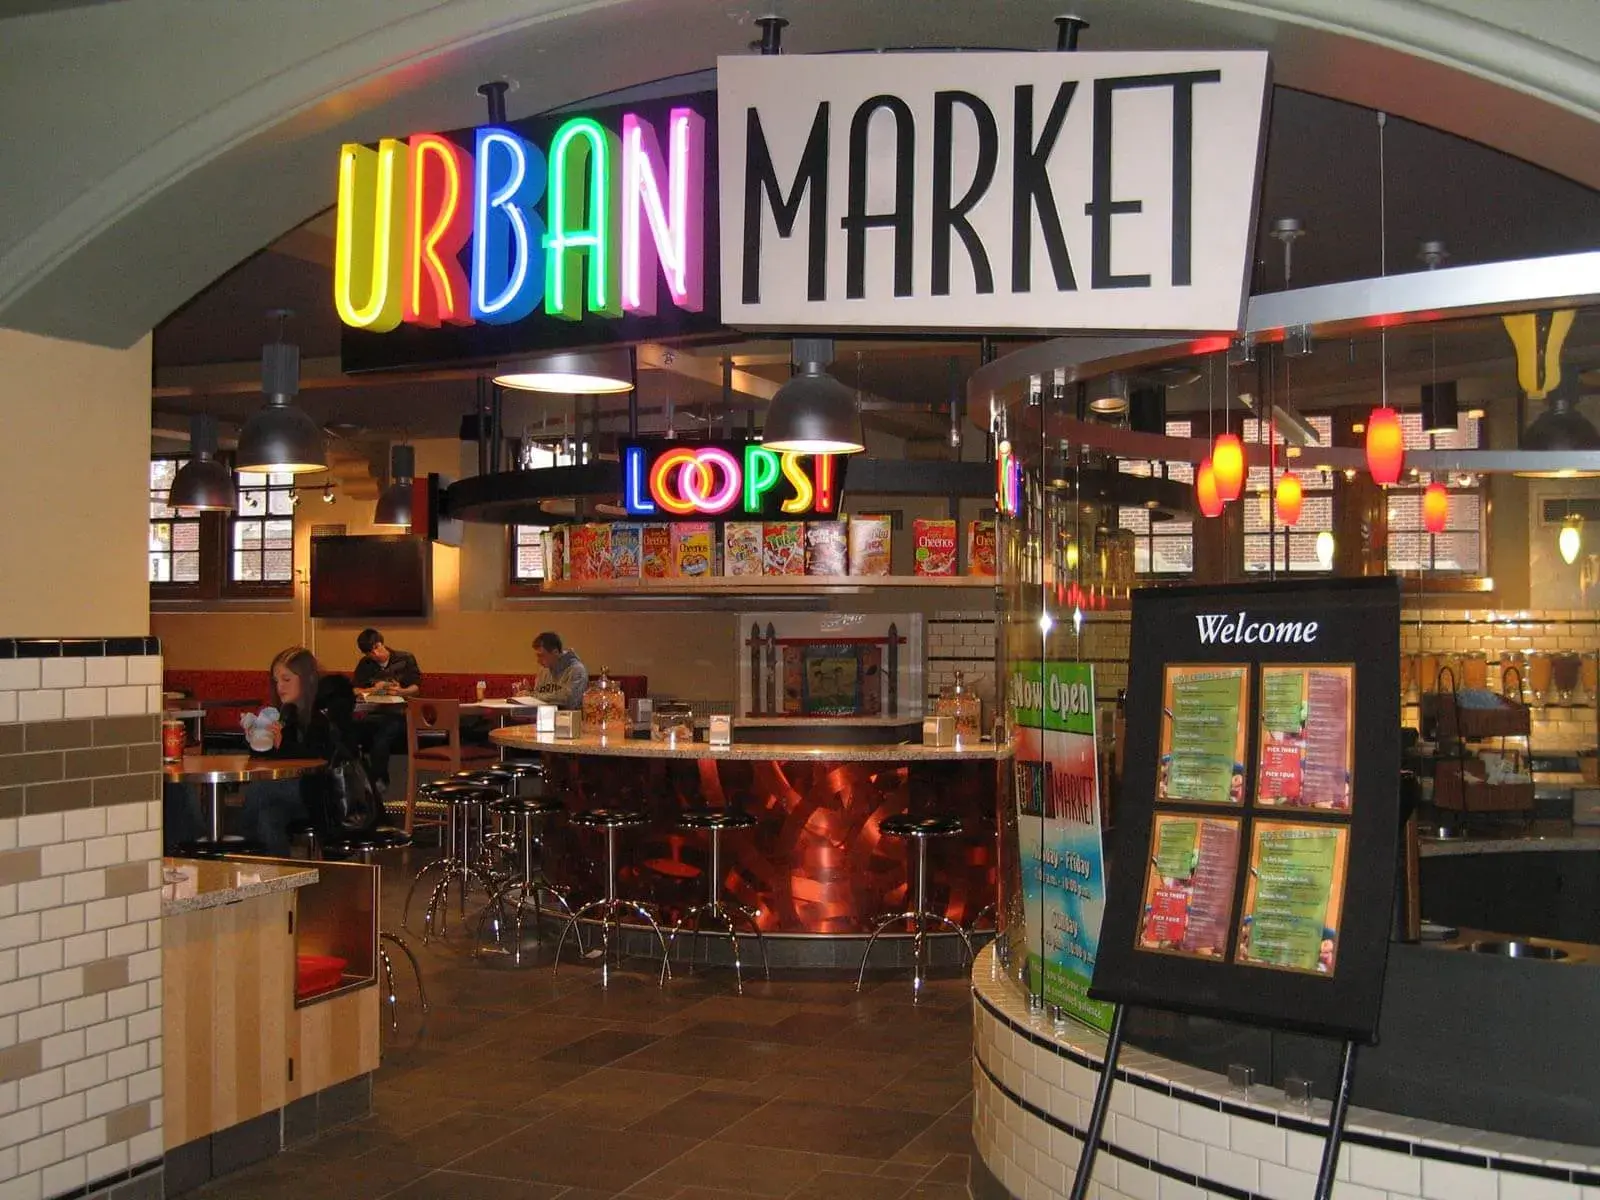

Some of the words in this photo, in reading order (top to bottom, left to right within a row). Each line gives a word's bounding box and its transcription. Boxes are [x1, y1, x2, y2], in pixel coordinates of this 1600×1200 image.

[334, 107, 706, 333] URBAN
[741, 68, 1222, 305] MARKET
[626, 444, 834, 515] LOOPS!
[680, 543, 707, 552] Cheerios
[919, 536, 954, 547] Cheerios
[1195, 611, 1319, 644] Welcome
[1012, 673, 1042, 710] Now
[1049, 673, 1090, 722] Open
[1054, 769, 1094, 825] MARKET
[1065, 850, 1090, 880] Friday
